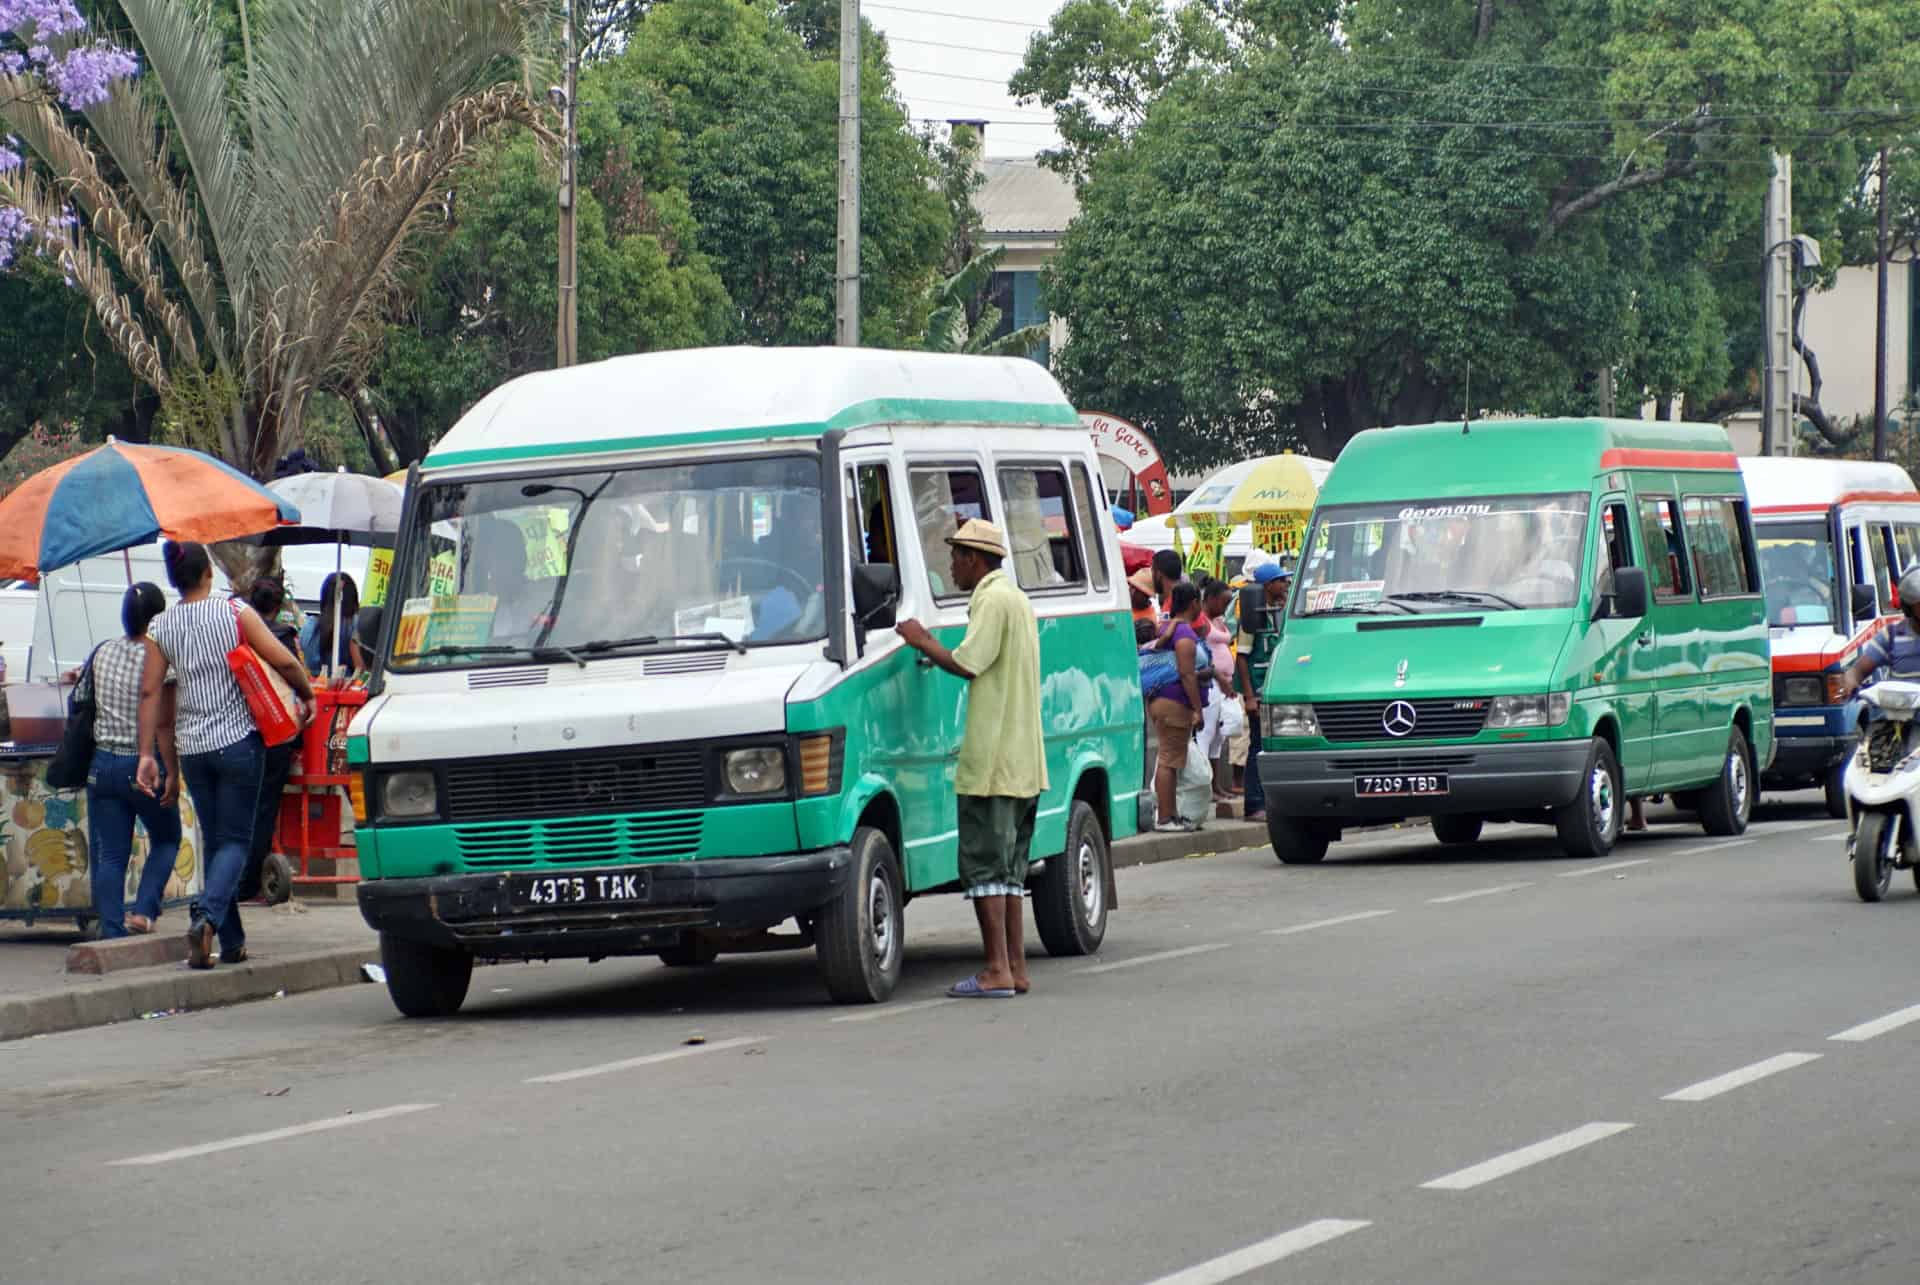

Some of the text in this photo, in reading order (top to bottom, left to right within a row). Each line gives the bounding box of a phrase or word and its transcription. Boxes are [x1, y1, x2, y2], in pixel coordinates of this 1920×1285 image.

[1115, 427, 1149, 456] Gare
[1398, 504, 1490, 521] Germany
[1363, 776, 1437, 793] 7209 TBD
[596, 874, 639, 899] TAK
